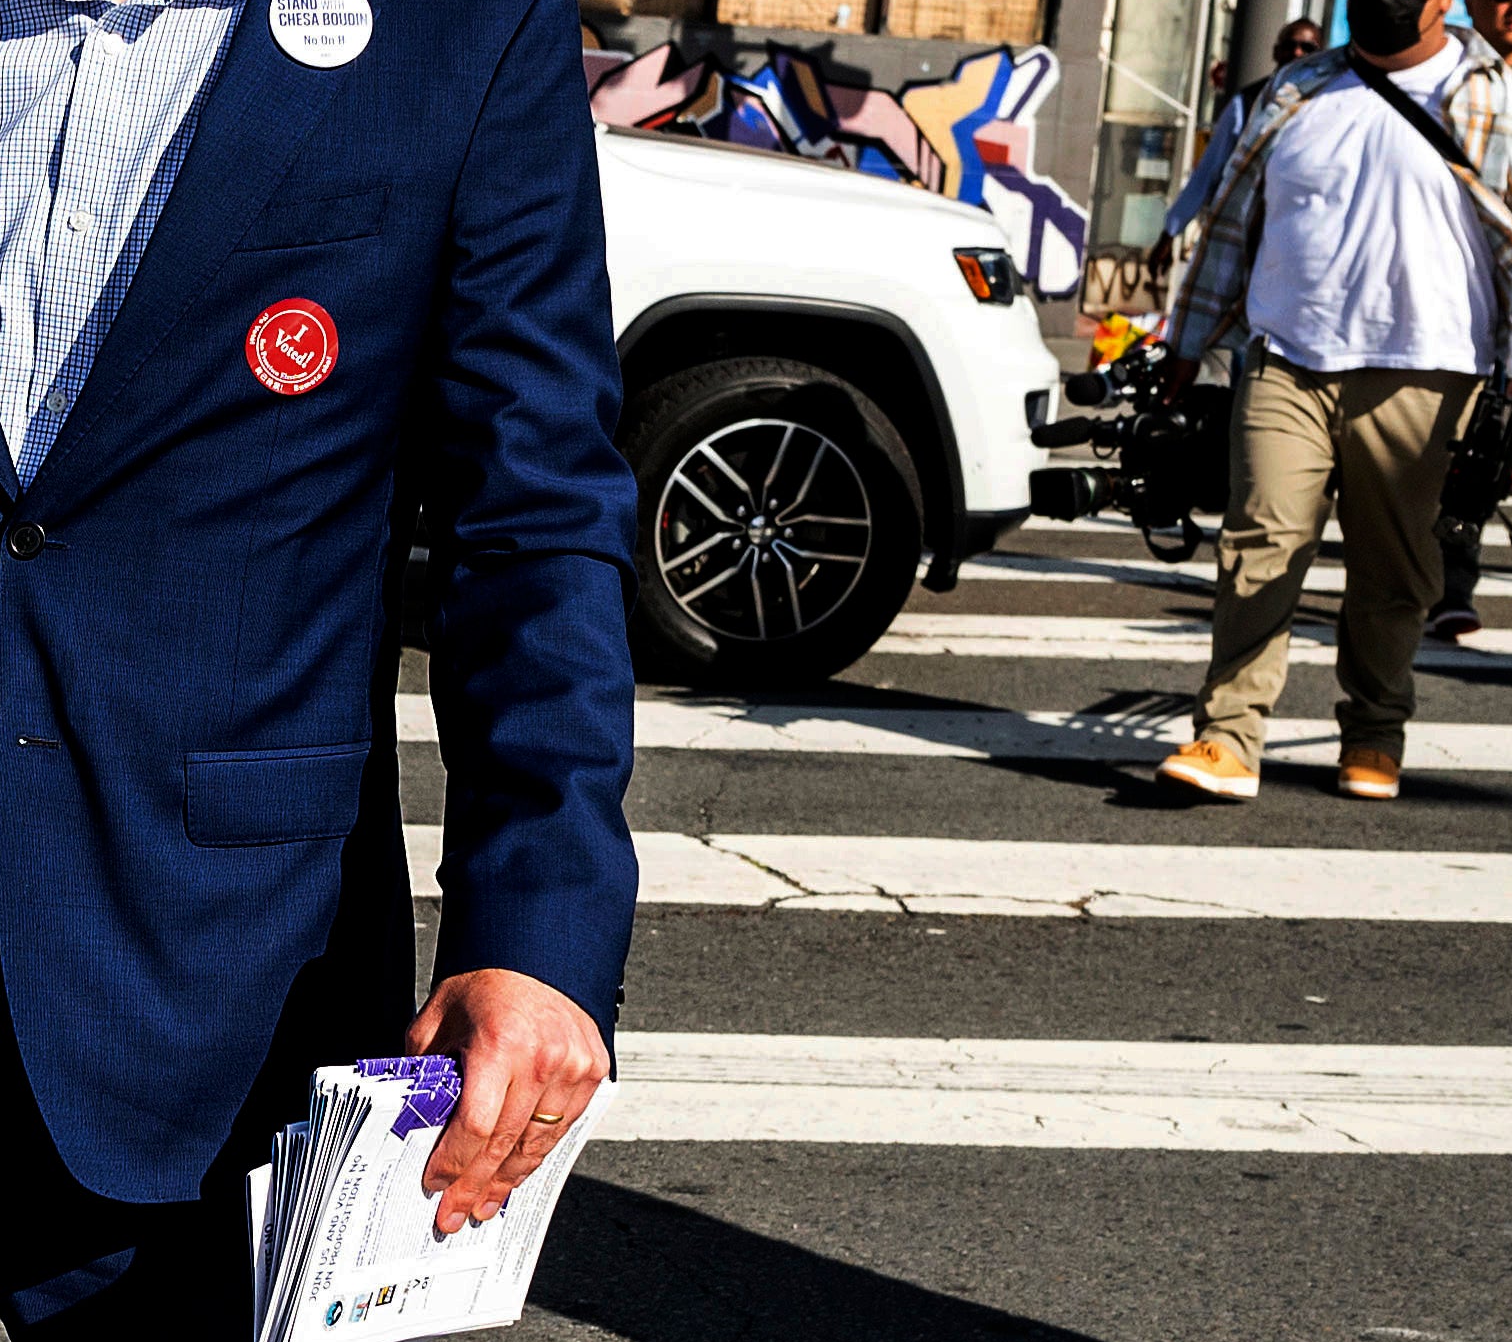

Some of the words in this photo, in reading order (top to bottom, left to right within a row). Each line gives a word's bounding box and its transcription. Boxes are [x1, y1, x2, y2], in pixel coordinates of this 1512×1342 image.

[321, 0, 345, 11] WITH
[279, 12, 319, 27] CHESA
[322, 12, 368, 27] BOUDIN
[304, 35, 318, 46] No
[321, 35, 335, 46] On
[293, 323, 309, 343] I
[275, 327, 315, 369] Voted!
[309, 1270, 324, 1302] JOIN
[319, 1248, 330, 1266] US
[326, 1215, 340, 1242] AND
[336, 1177, 353, 1210] VOTE
[349, 1154, 363, 1173] NO
[322, 1271, 334, 1290] ON
[329, 1176, 363, 1266] PROPOSITION
